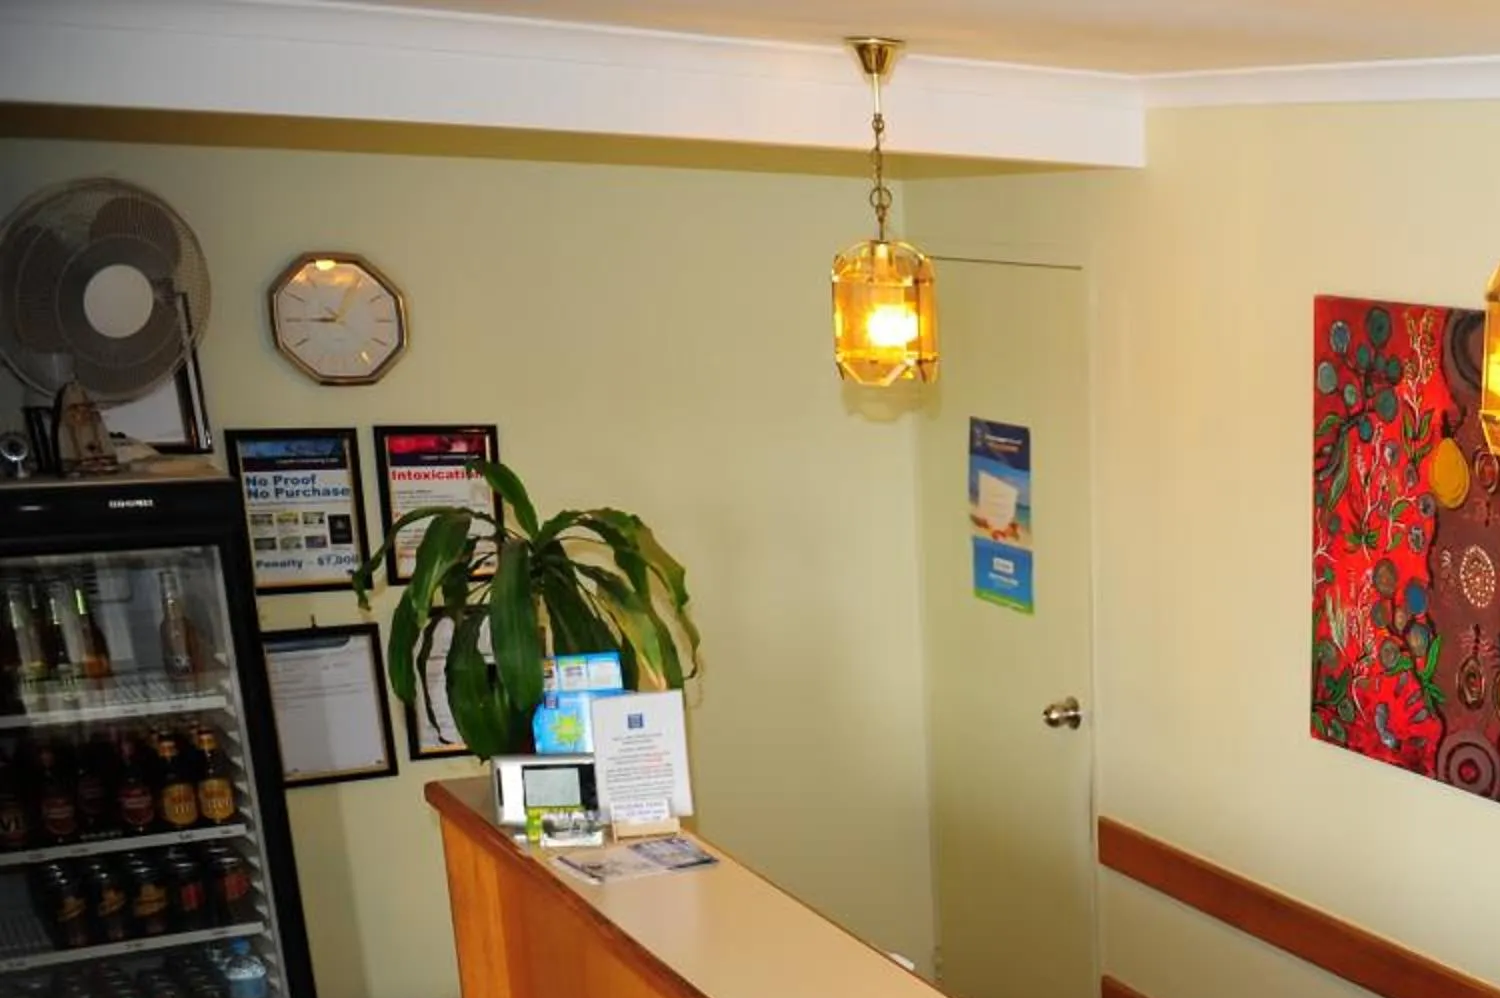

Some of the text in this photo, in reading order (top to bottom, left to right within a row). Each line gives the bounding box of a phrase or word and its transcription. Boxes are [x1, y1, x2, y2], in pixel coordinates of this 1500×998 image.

[245, 473, 316, 487] No Proof
[247, 486, 350, 499] No Purchase
